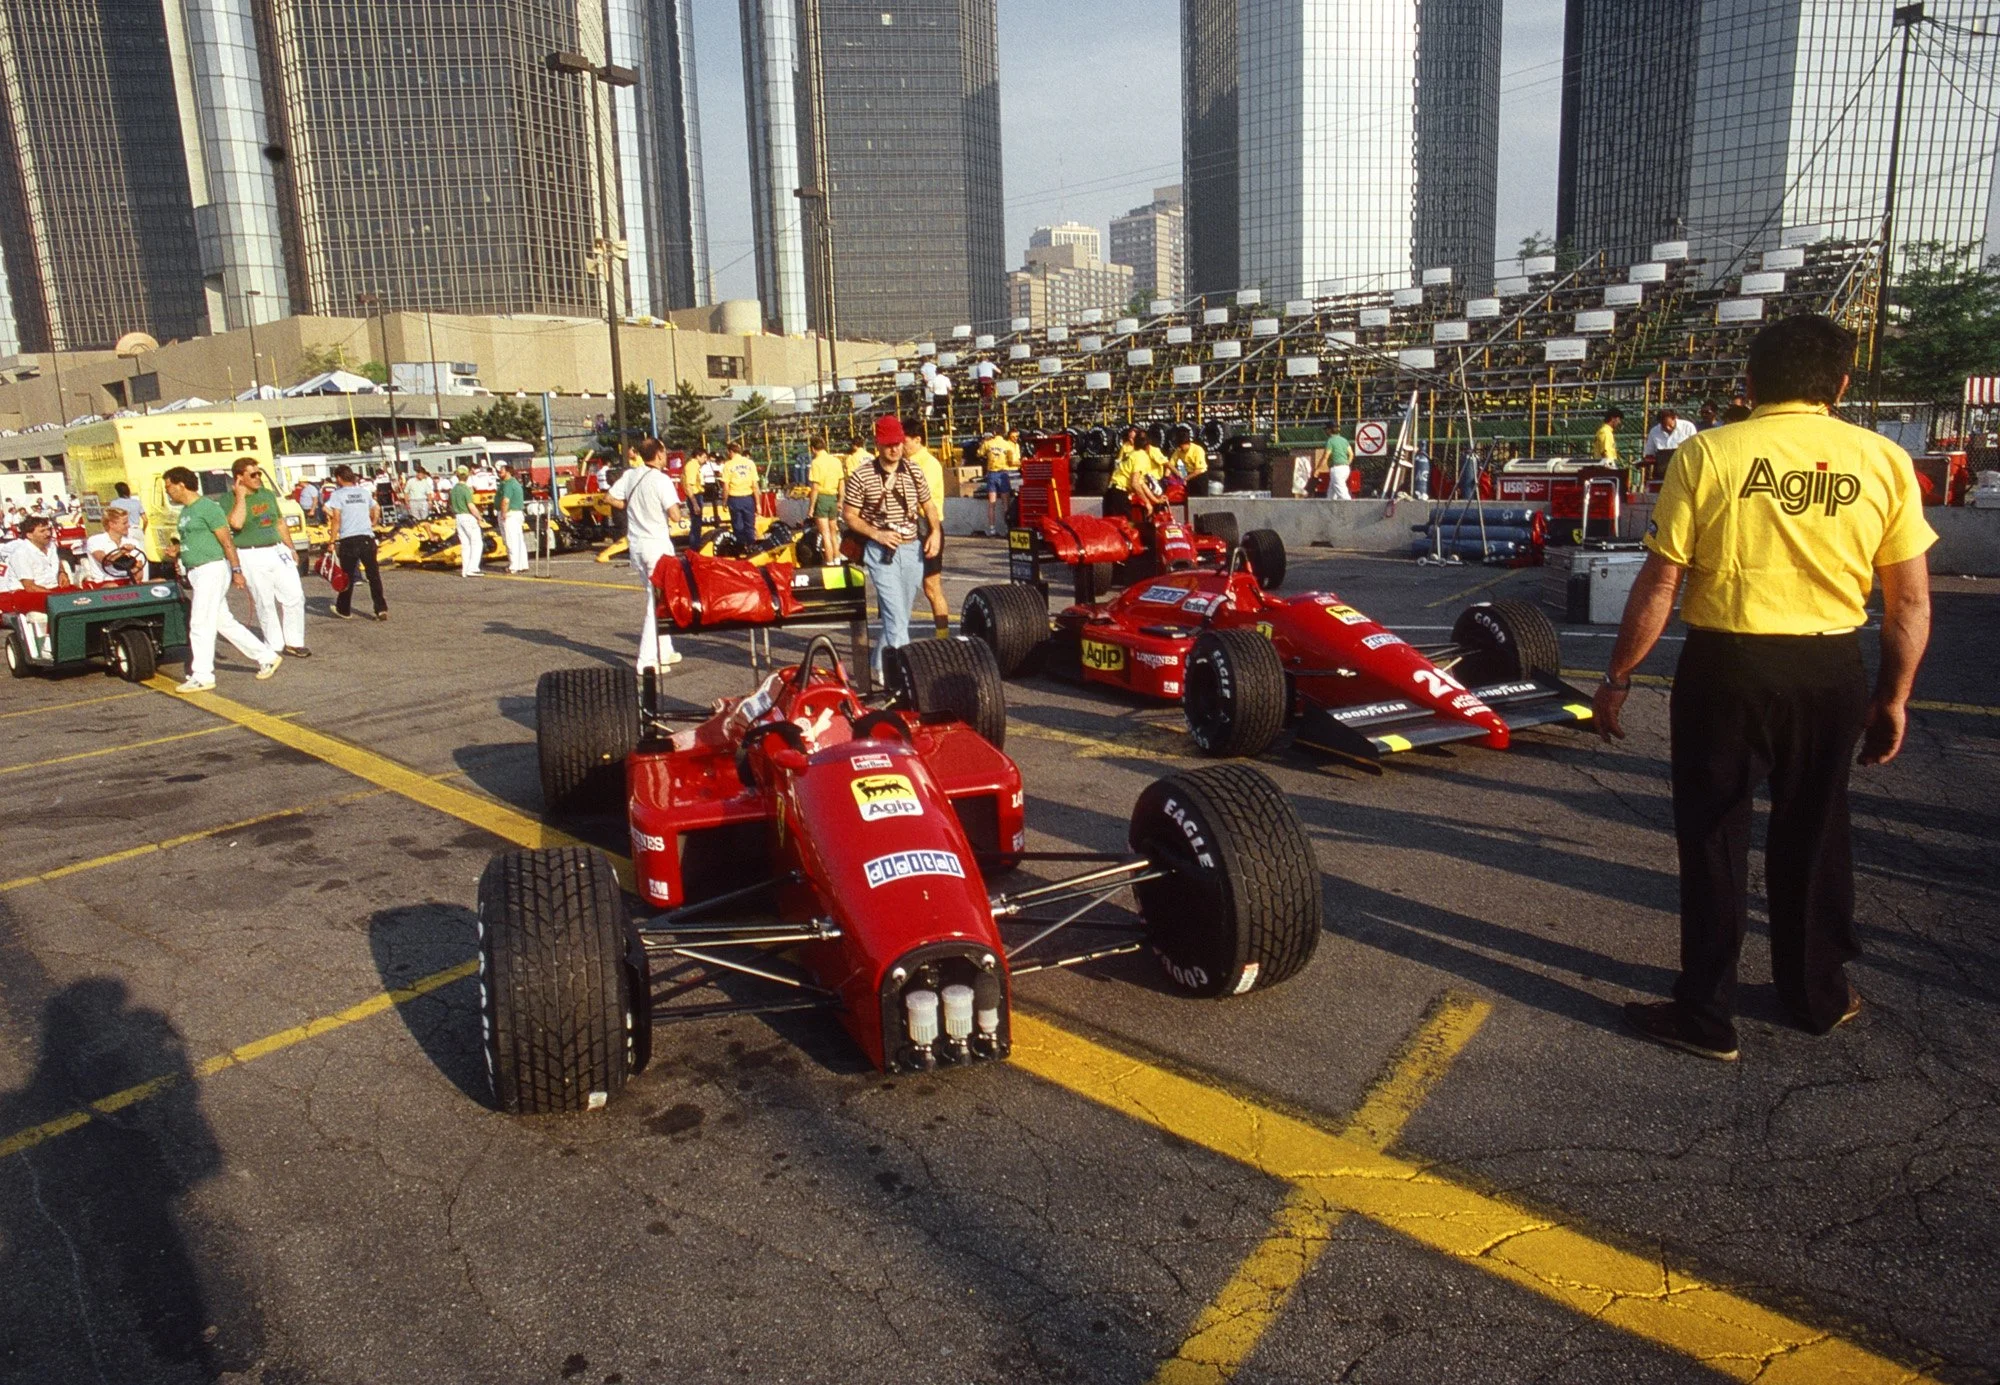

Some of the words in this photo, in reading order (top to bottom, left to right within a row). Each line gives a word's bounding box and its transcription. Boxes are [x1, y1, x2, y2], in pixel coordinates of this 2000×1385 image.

[139, 436, 258, 458] RYDER
[1738, 457, 1861, 517] Agip
[1086, 641, 1121, 668] Agip
[1136, 651, 1179, 666] LONGINES
[1333, 703, 1408, 721] GOODYEAR
[868, 799, 916, 816] Agip
[1163, 798, 1215, 869] EAGLE
[866, 852, 962, 885] digital
